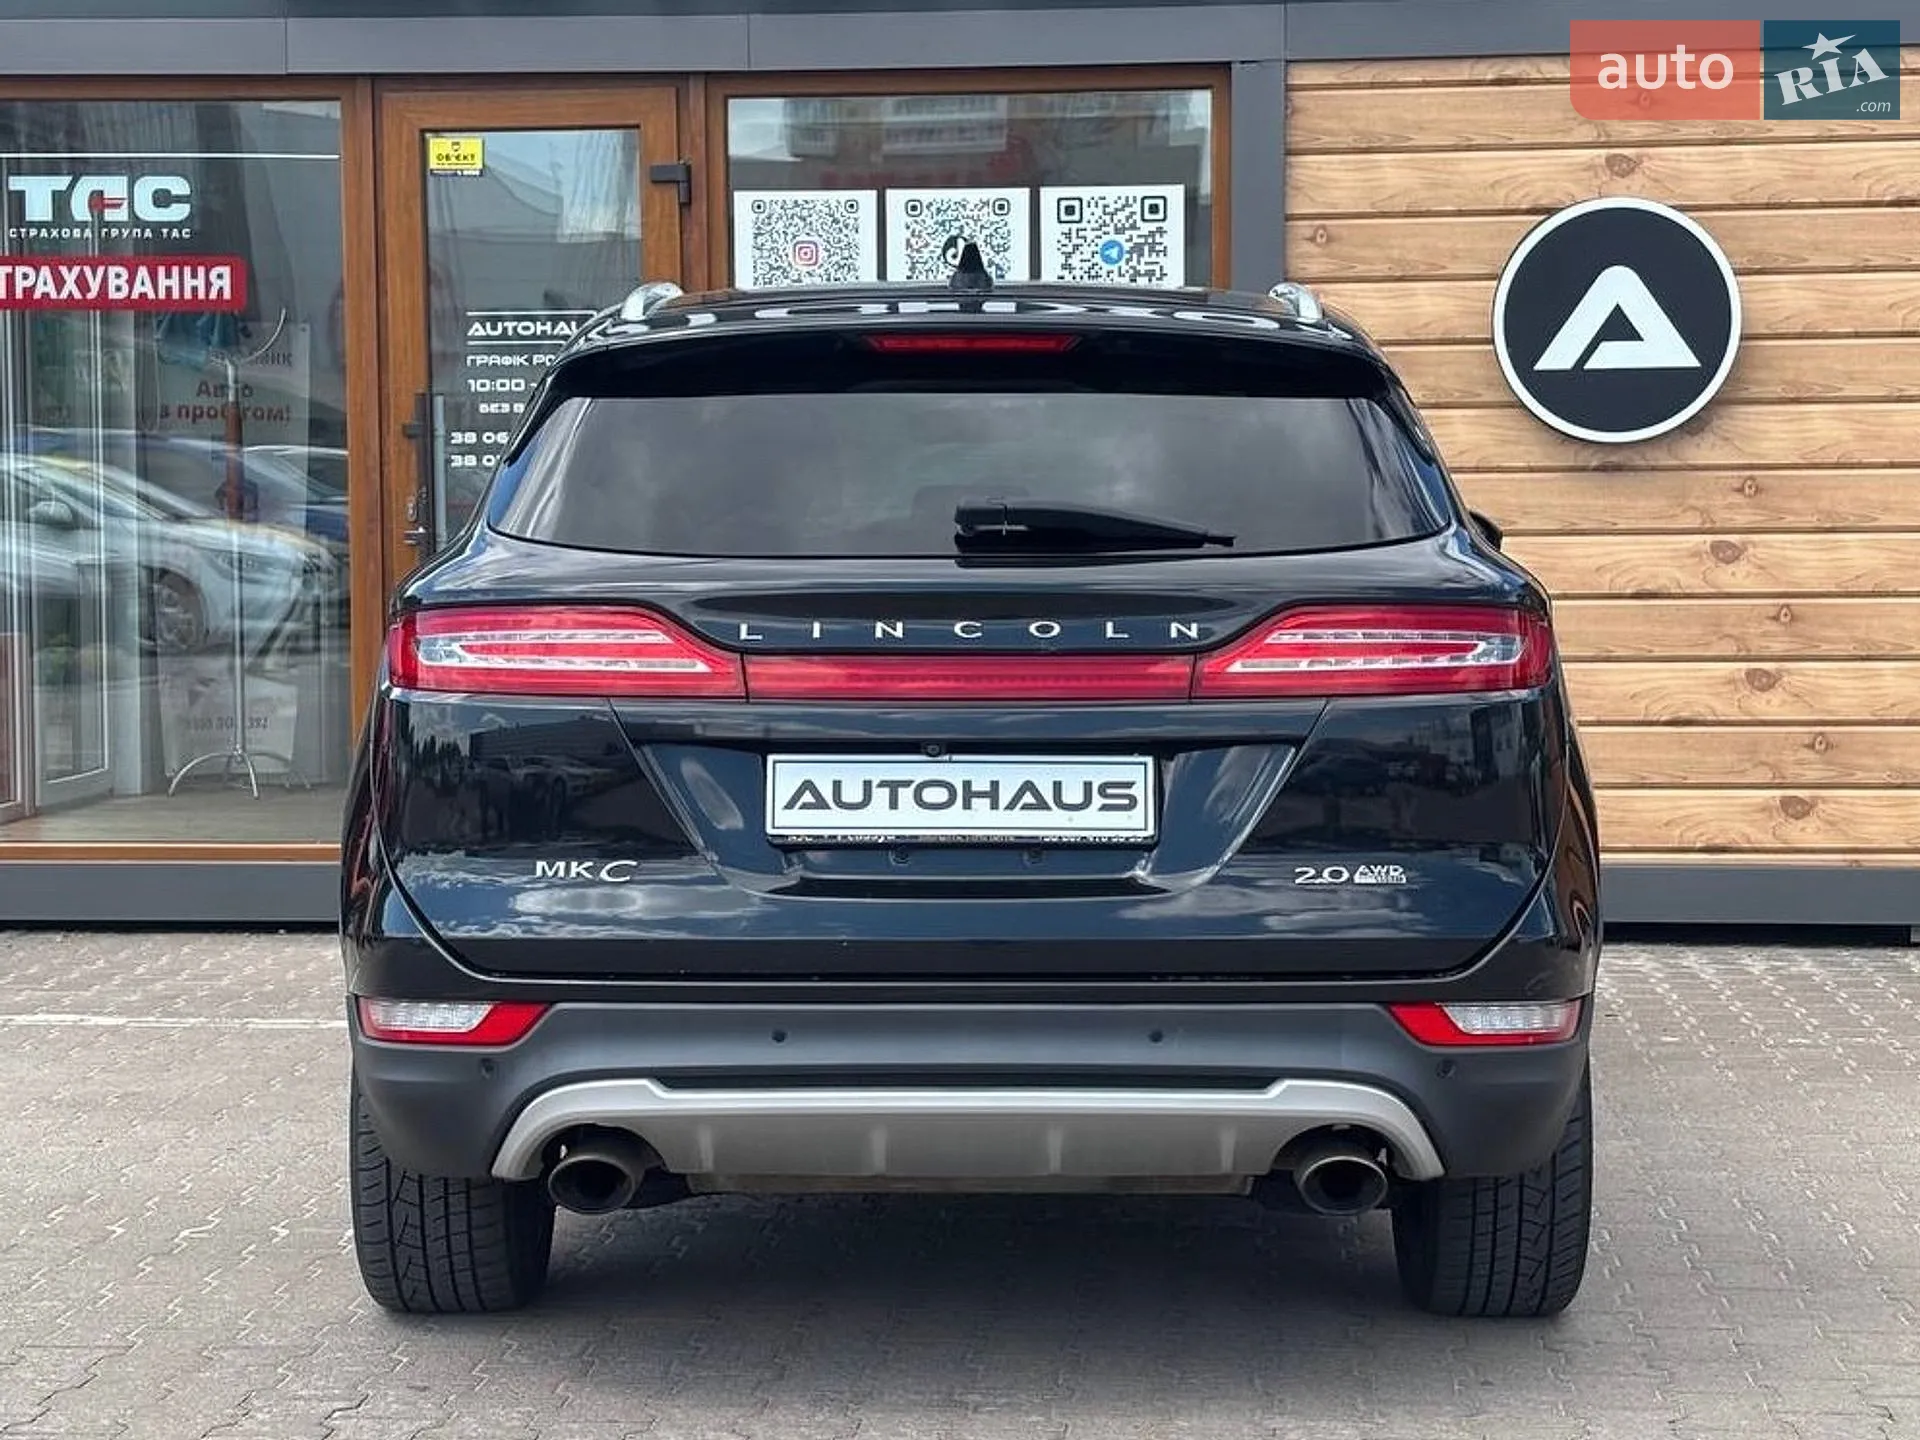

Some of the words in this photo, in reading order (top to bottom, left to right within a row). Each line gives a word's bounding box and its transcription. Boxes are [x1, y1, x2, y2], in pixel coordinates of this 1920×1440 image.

[8, 176, 191, 221] ТАС
[9, 228, 92, 239] СТРАХОВА
[102, 228, 153, 239] ГРУПА
[161, 228, 192, 239] ТАС
[466, 354, 530, 367] ГРАФІК
[467, 379, 525, 392] 10:00
[450, 432, 477, 444] 38
[450, 454, 477, 468] 38
[739, 620, 1198, 641] LINCOLN
[782, 778, 1138, 812] AUTOHAUS
[536, 860, 638, 882] MKC
